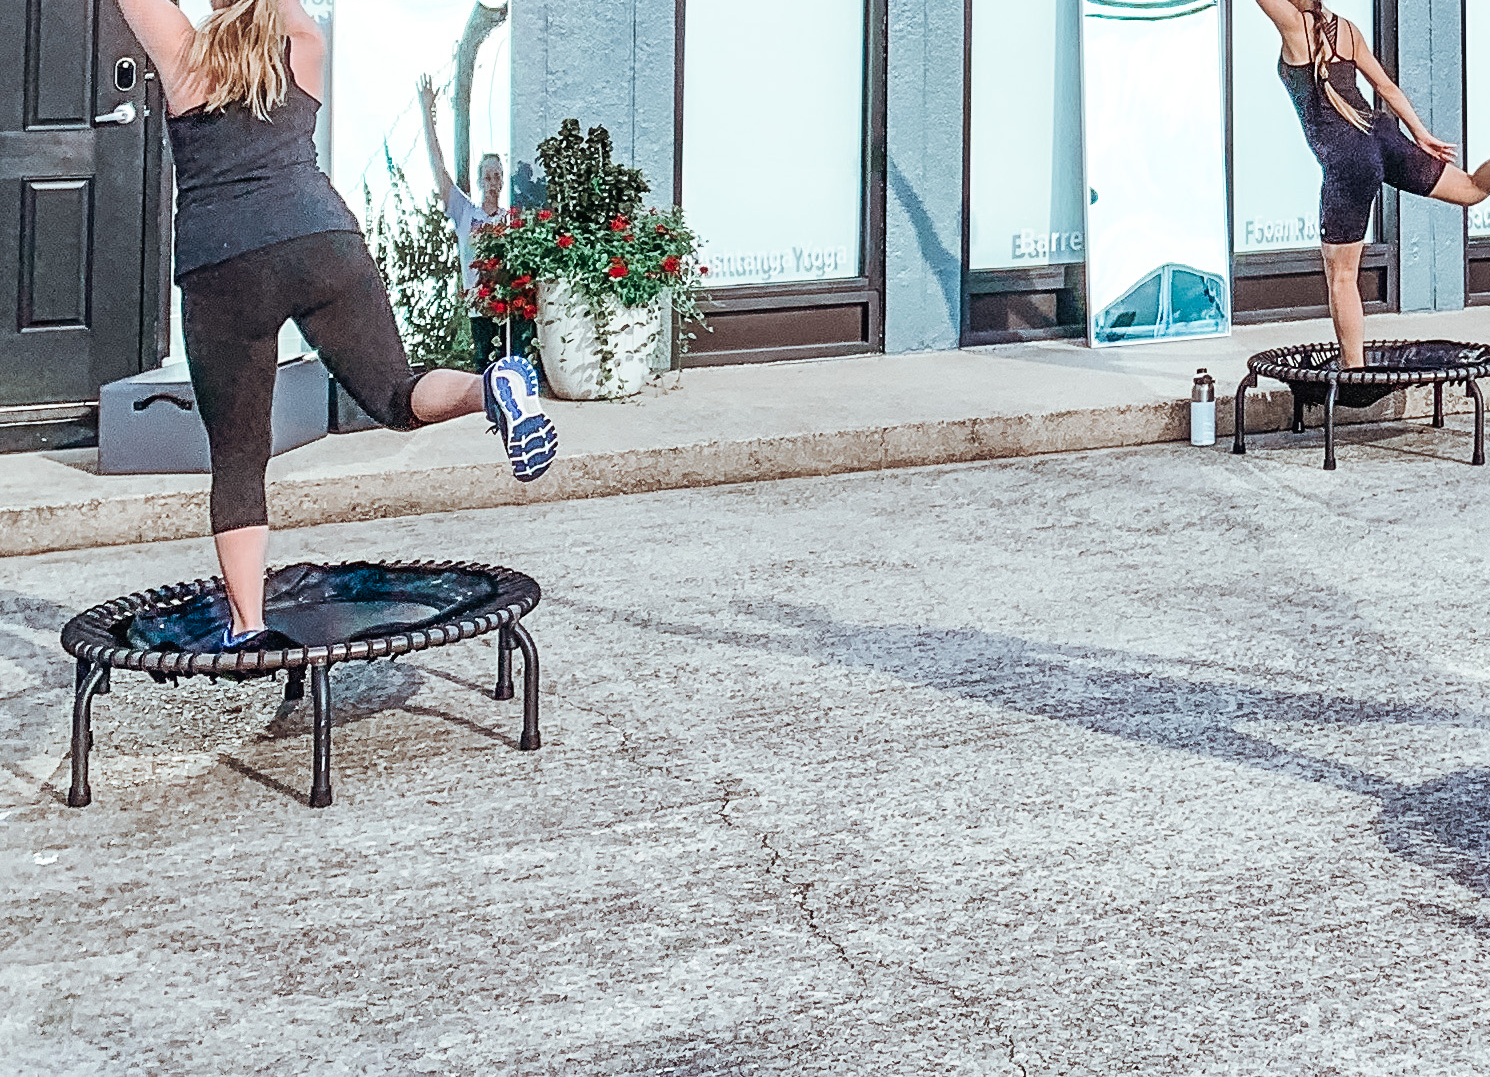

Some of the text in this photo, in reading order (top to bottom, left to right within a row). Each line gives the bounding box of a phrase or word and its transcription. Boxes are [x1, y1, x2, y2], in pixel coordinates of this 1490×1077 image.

[1254, 214, 1297, 239] Foam
[1019, 227, 1083, 254] Barre
[798, 238, 847, 273] Yoga
